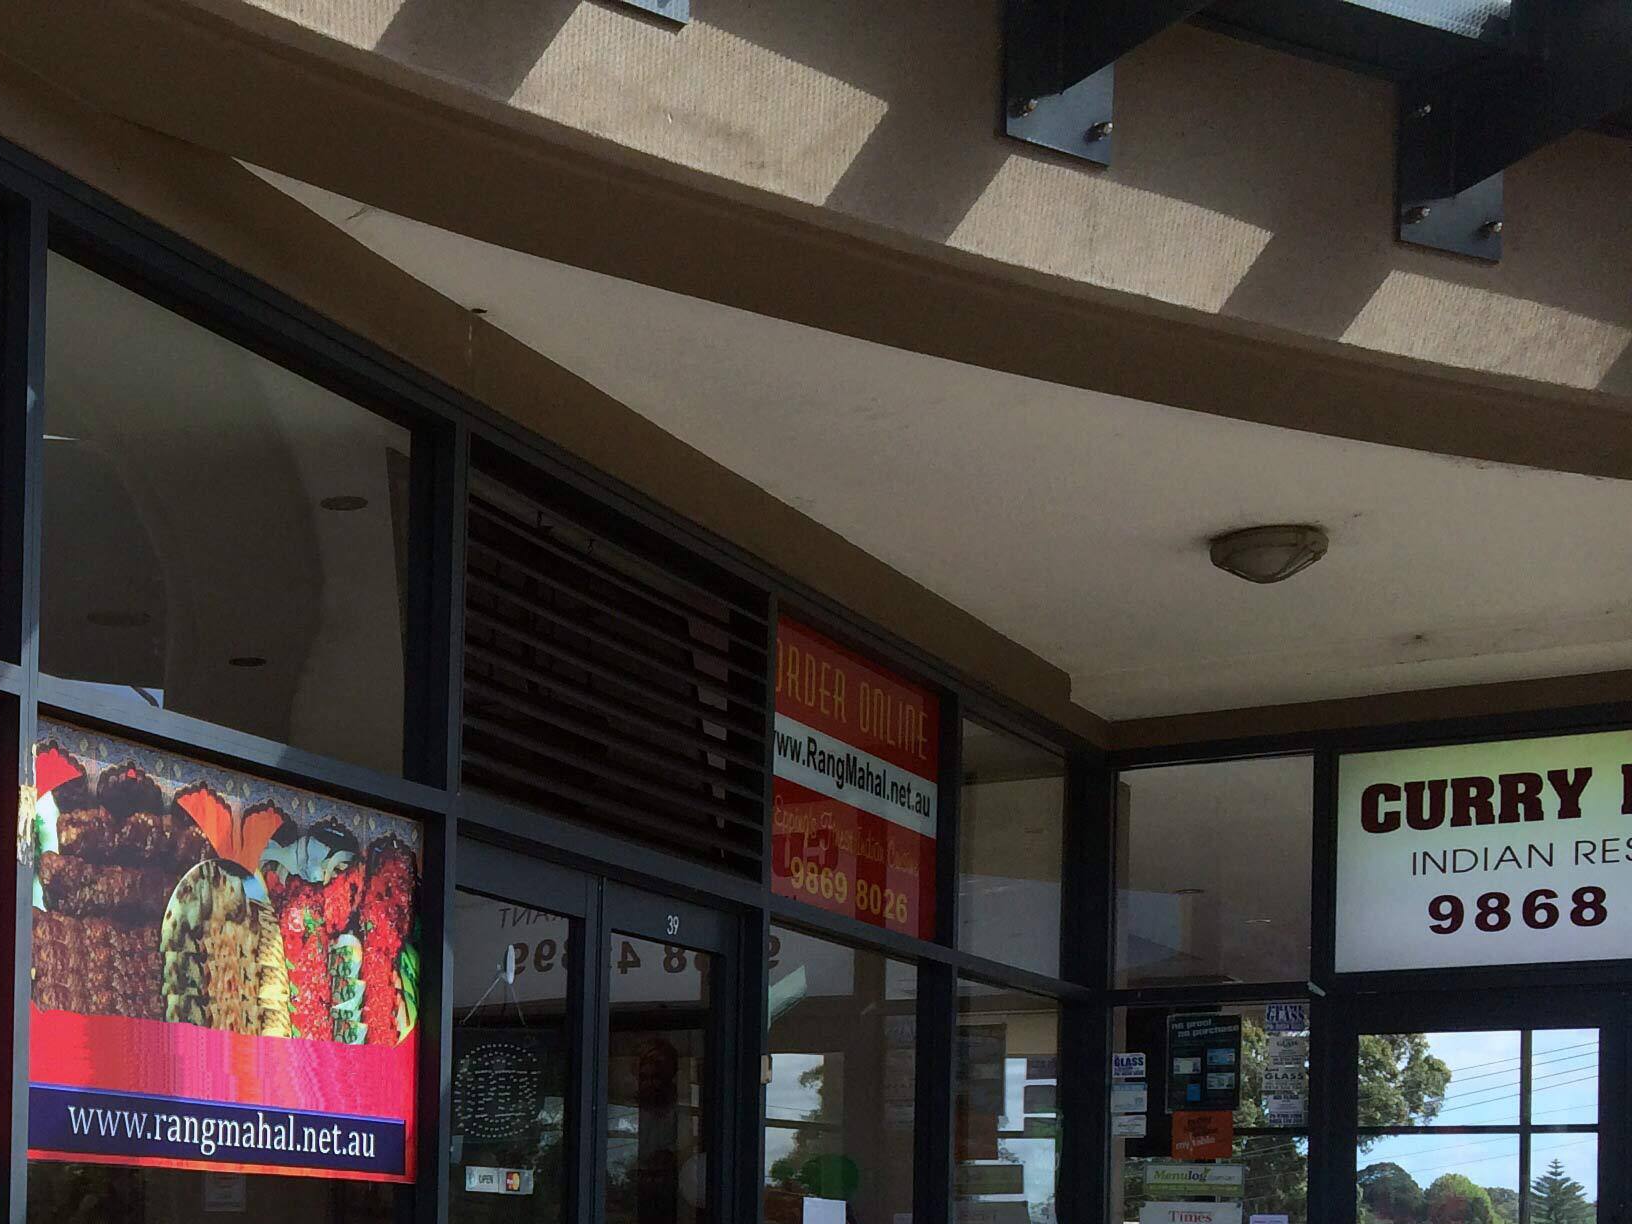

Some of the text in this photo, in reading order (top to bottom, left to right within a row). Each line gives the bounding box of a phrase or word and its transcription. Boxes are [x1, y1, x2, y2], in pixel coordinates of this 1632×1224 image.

[859, 682, 928, 761] ONLINE
[773, 731, 931, 818] ww.RangMahal.net.au
[1361, 767, 1593, 834] CURRY
[1412, 843, 1554, 876] INDIAN
[790, 857, 908, 924] 9869 8026
[1428, 886, 1608, 935] 9868
[666, 915, 680, 936] 39
[1114, 1056, 1144, 1068] GLASS
[1264, 1072, 1304, 1080] GLASS
[68, 1105, 376, 1159] www.rangmahal.net.au
[1153, 1168, 1208, 1182] Menulog
[1168, 1210, 1213, 1223] Times
